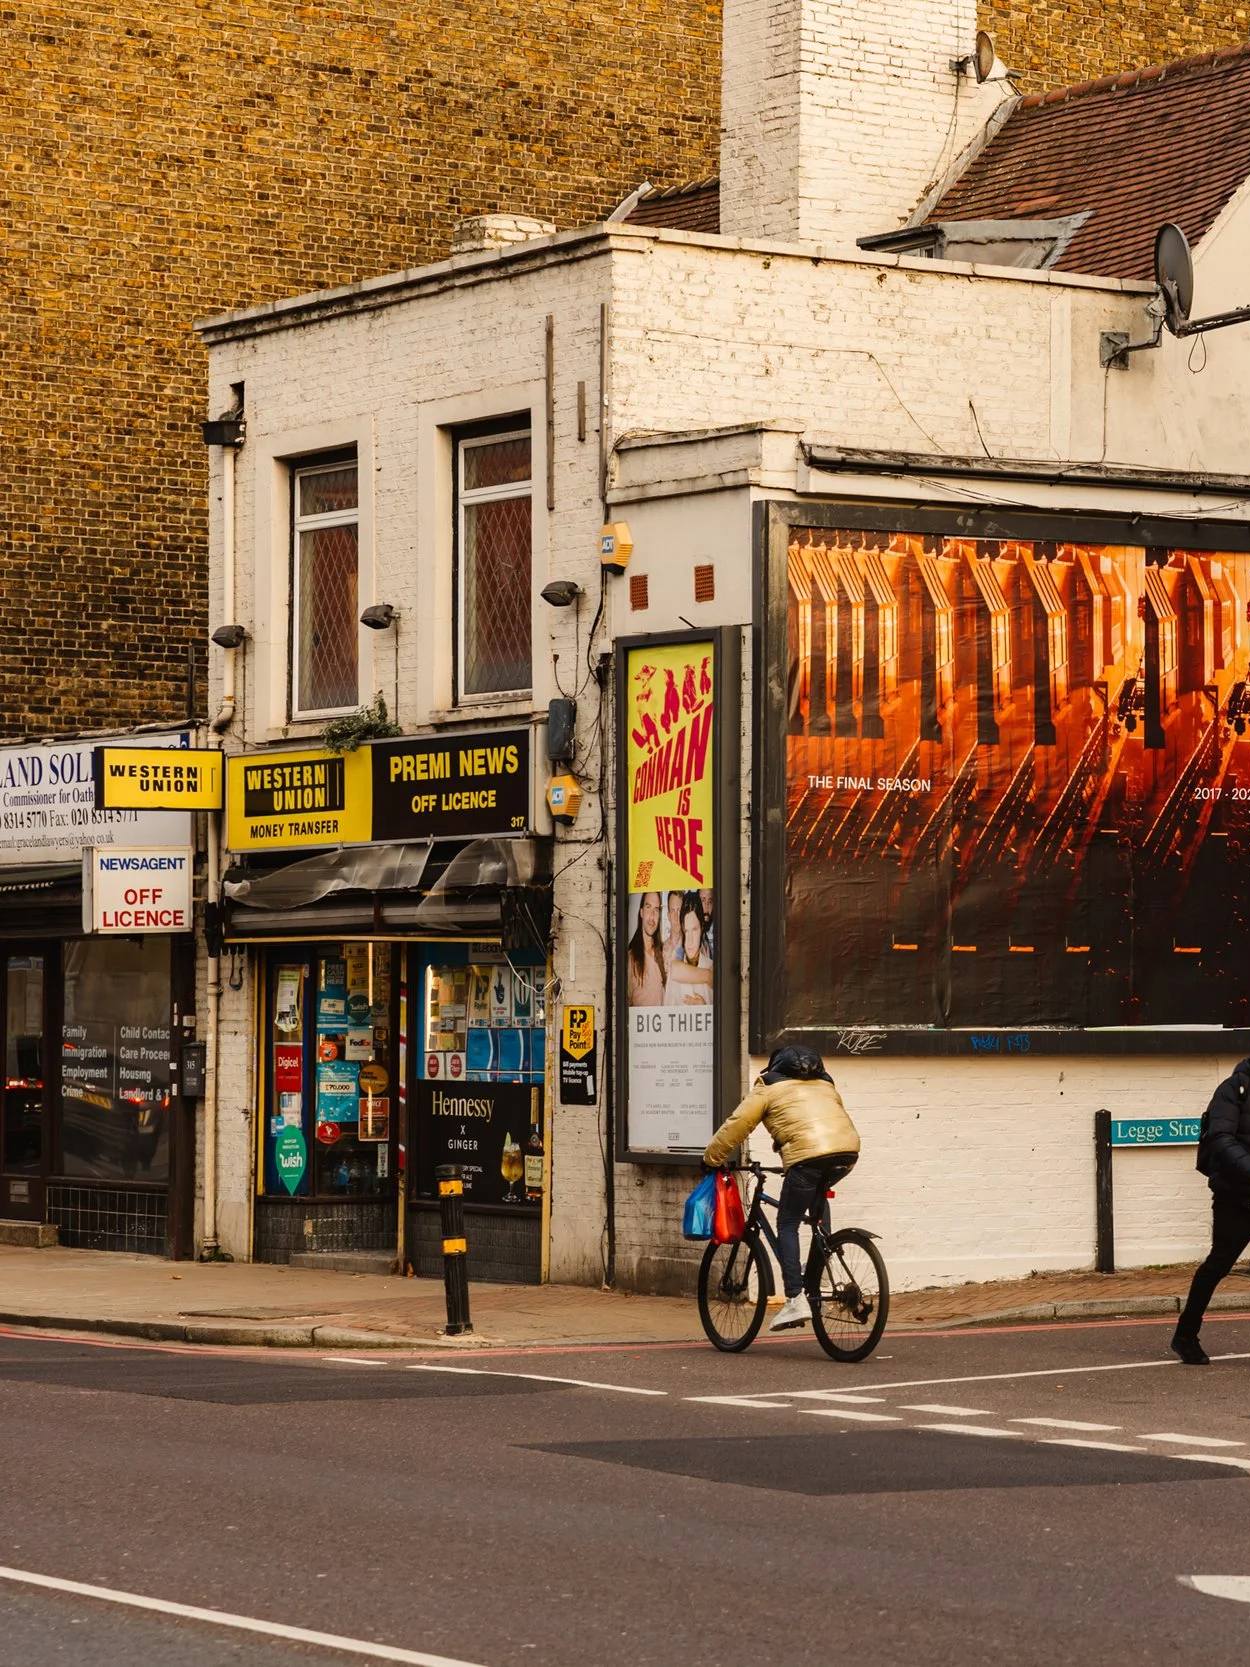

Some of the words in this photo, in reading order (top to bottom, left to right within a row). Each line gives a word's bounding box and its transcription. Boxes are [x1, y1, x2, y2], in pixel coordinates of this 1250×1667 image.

[633, 702, 713, 804] CONMAN
[110, 764, 198, 779] WESTERN
[390, 752, 450, 782] PREMI
[460, 745, 519, 777] NEWS
[0, 756, 43, 789] AND
[246, 764, 325, 790] WESTERN
[140, 780, 198, 793] UNION
[808, 776, 834, 789] THE
[837, 776, 874, 790] FINAL
[877, 778, 931, 792] SEASON
[3, 792, 57, 808] Commissioner
[59, 789, 70, 805] for
[273, 788, 325, 811] UNION
[412, 795, 437, 813] OFF
[442, 790, 497, 811] LICENCE
[677, 787, 691, 816] IS
[1194, 788, 1222, 800] 2017
[4, 812, 25, 830] 8314
[27, 810, 48, 828] 5770
[50, 809, 69, 826] Fax:
[71, 808, 88, 826] 020
[510, 817, 525, 828] 317
[250, 823, 285, 839] MONEY
[288, 820, 339, 836] TRANSFER
[655, 816, 704, 885] HERE
[100, 858, 186, 870] NEWSAGENT
[124, 889, 163, 906] OFF
[103, 910, 184, 927] LICENCE
[636, 1013, 662, 1033] BIG
[668, 1012, 713, 1032] THIEF
[62, 1026, 87, 1040] Family
[120, 1026, 140, 1039] Child
[570, 1030, 582, 1042] Pay
[62, 1046, 107, 1060] Immigration
[120, 1047, 138, 1060] Care
[569, 1040, 587, 1049] Point
[186, 1061, 196, 1070] 315
[278, 1056, 299, 1070] Digicel
[62, 1065, 108, 1080] Employment
[120, 1068, 152, 1083] Housing
[62, 1085, 84, 1098] Crime
[119, 1088, 154, 1101] Landlord
[155, 1089, 162, 1101] &
[432, 1091, 494, 1123] Hennessy
[1117, 1122, 1163, 1143] Legge
[448, 1139, 478, 1151] GINGER
[280, 1152, 303, 1169] wish
